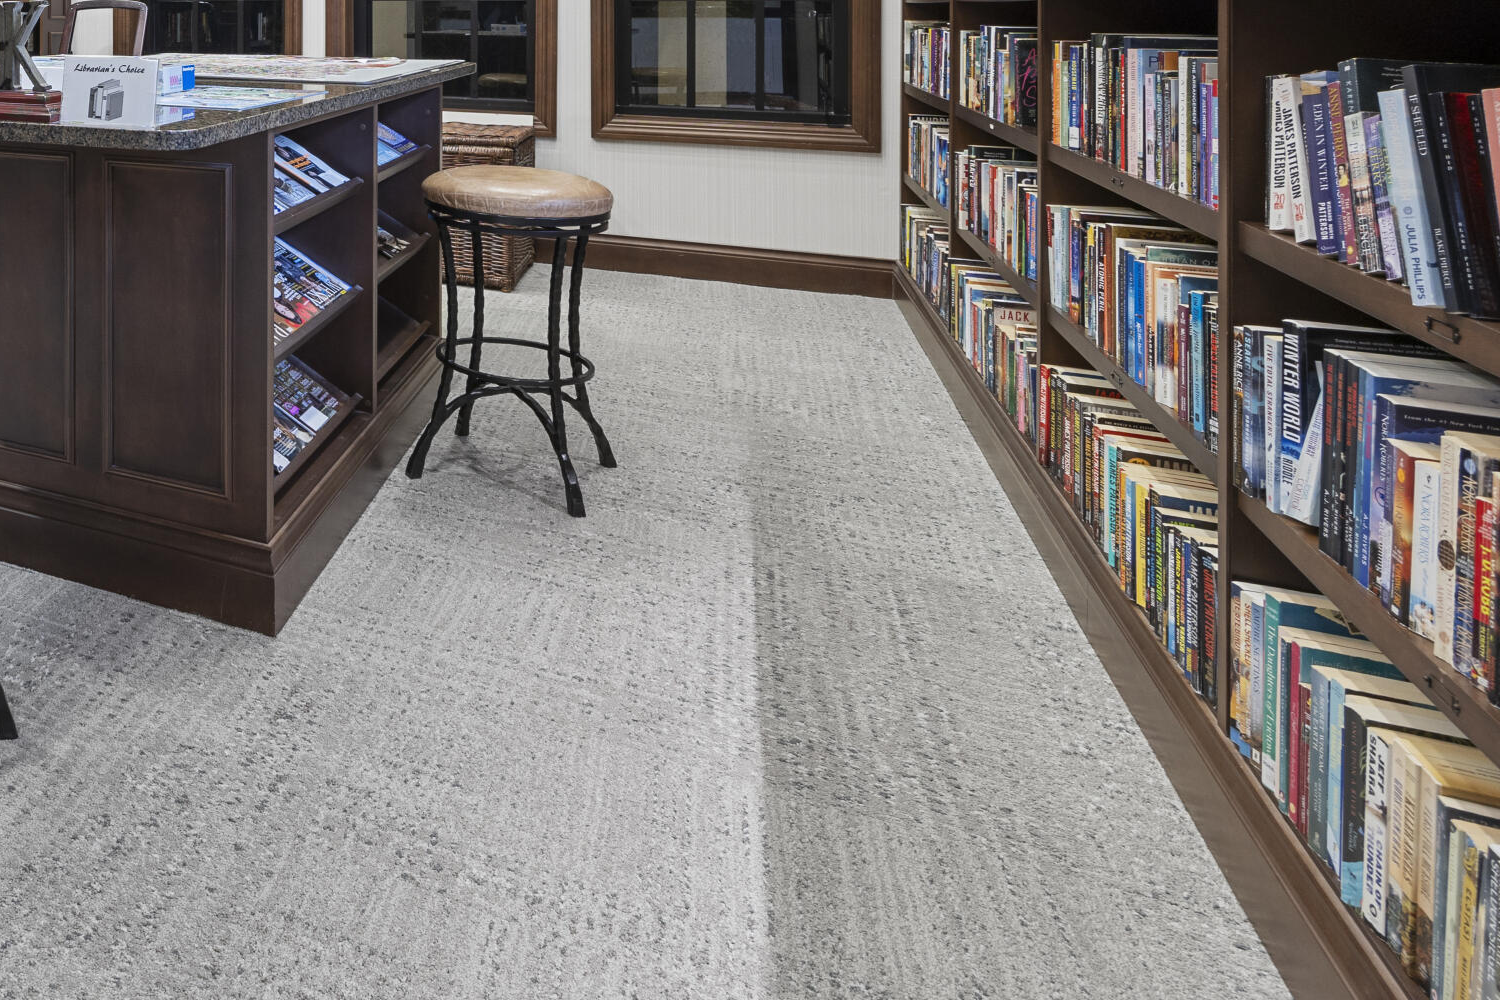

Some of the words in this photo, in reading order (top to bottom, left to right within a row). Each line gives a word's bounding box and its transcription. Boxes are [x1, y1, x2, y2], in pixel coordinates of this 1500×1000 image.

[74, 63, 116, 74] Librarian's
[118, 64, 146, 75] Choice
[1329, 87, 1341, 119] ANNE
[1345, 80, 1355, 114] KAREN
[1408, 94, 1418, 103] IF
[1281, 108, 1296, 142] JAMES
[1312, 103, 1324, 130] EDEN
[1410, 105, 1422, 130] SHE
[1315, 134, 1324, 146] IN
[1332, 122, 1346, 161] PERRY
[1415, 130, 1428, 156] FLED
[1286, 144, 1302, 201] PATTERSON
[1316, 149, 1329, 193] WINTER
[1369, 146, 1383, 188] PERRY
[1317, 202, 1328, 242] PATTERSON
[1405, 223, 1419, 252] JULIA
[1457, 221, 1467, 250] BLAKE
[1434, 227, 1446, 253] BLAKE
[1440, 256, 1453, 290] PIERCE
[1410, 255, 1426, 300] PHILLIPS
[999, 308, 1031, 323] JACK
[1235, 340, 1244, 373] ANNE
[1283, 333, 1300, 389] WINTER
[1236, 374, 1244, 394] RICE
[1283, 391, 1301, 444] WORLD
[1380, 413, 1390, 442] NORA
[1109, 460, 1117, 486] JAMES
[1282, 457, 1293, 487] RIDDLE
[1461, 474, 1478, 508] NORA
[1109, 487, 1117, 535] PATTERSON
[1322, 507, 1330, 539] RIVERS
[1460, 508, 1476, 556] ROBERTS
[1190, 553, 1198, 591] JAMES
[1204, 568, 1214, 604] JAMES
[1457, 577, 1474, 626] WHISKEY
[1480, 576, 1491, 616] ROBB
[1190, 592, 1199, 650] PATTERSON
[1205, 605, 1214, 661] PATTERSON
[1253, 607, 1261, 643] EMPIRE
[1267, 624, 1276, 645] The
[1454, 627, 1472, 660] BEACH
[1253, 645, 1261, 696] SETTINGS
[1267, 647, 1276, 697] Daughters
[1266, 696, 1273, 711] of
[1369, 735, 1377, 797] SHAARA
[1368, 830, 1376, 900] THUNDER
[1375, 889, 1382, 911] OF
